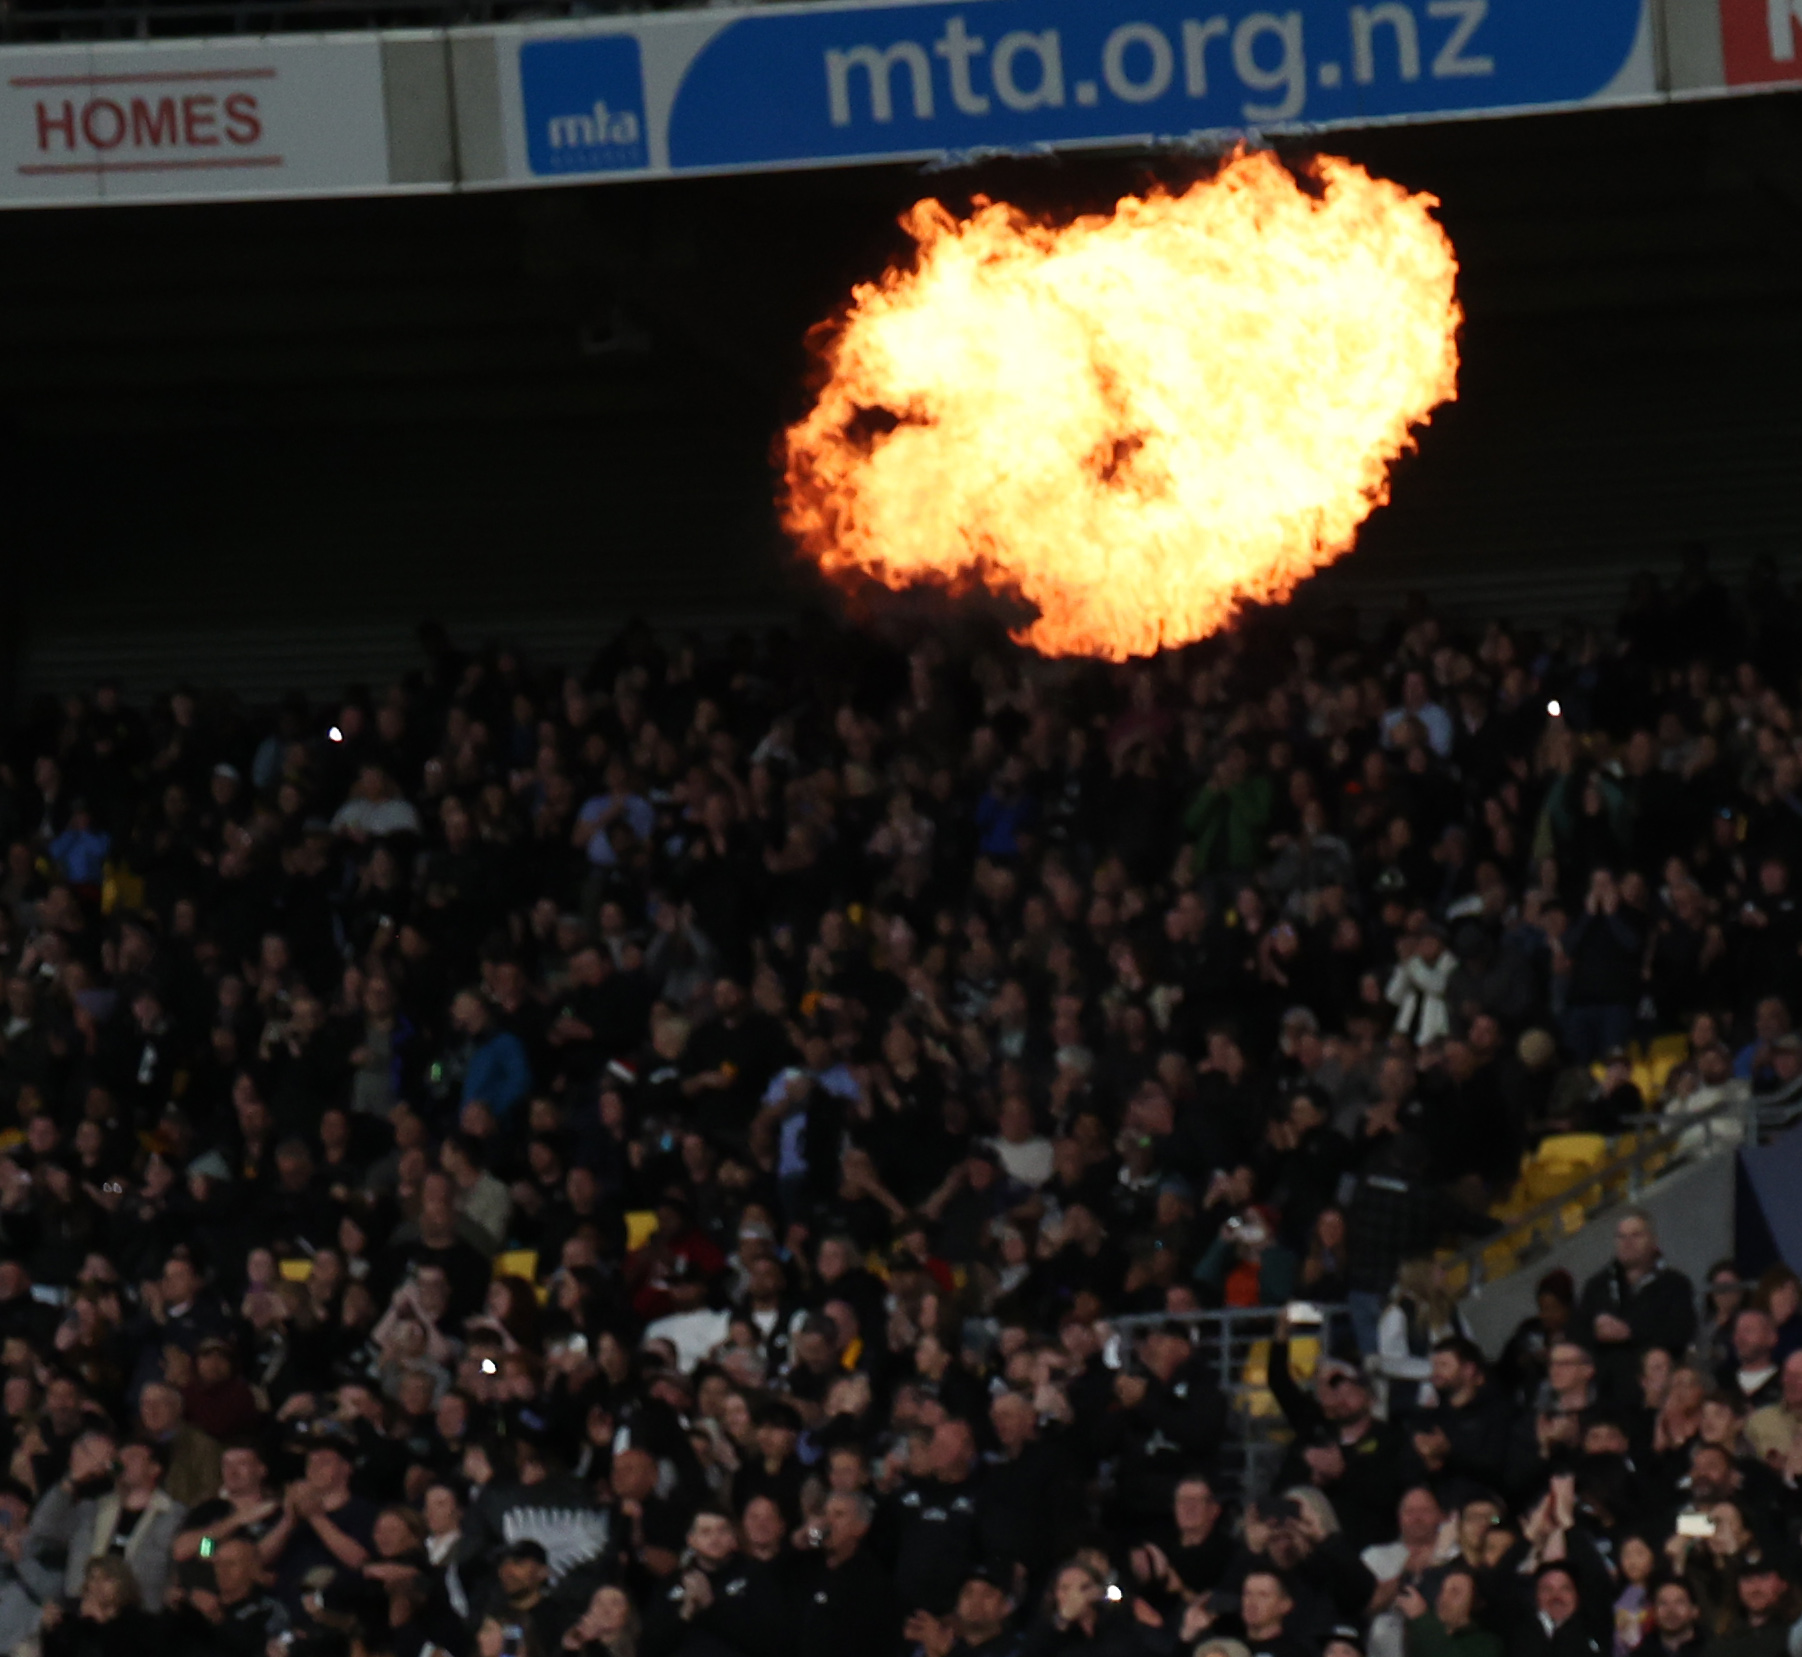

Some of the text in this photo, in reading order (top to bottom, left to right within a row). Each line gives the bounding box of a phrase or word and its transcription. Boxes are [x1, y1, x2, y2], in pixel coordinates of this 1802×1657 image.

[824, 0, 1495, 126] mta.org.nz
[35, 93, 263, 151] HOMES
[548, 99, 640, 149] mta
